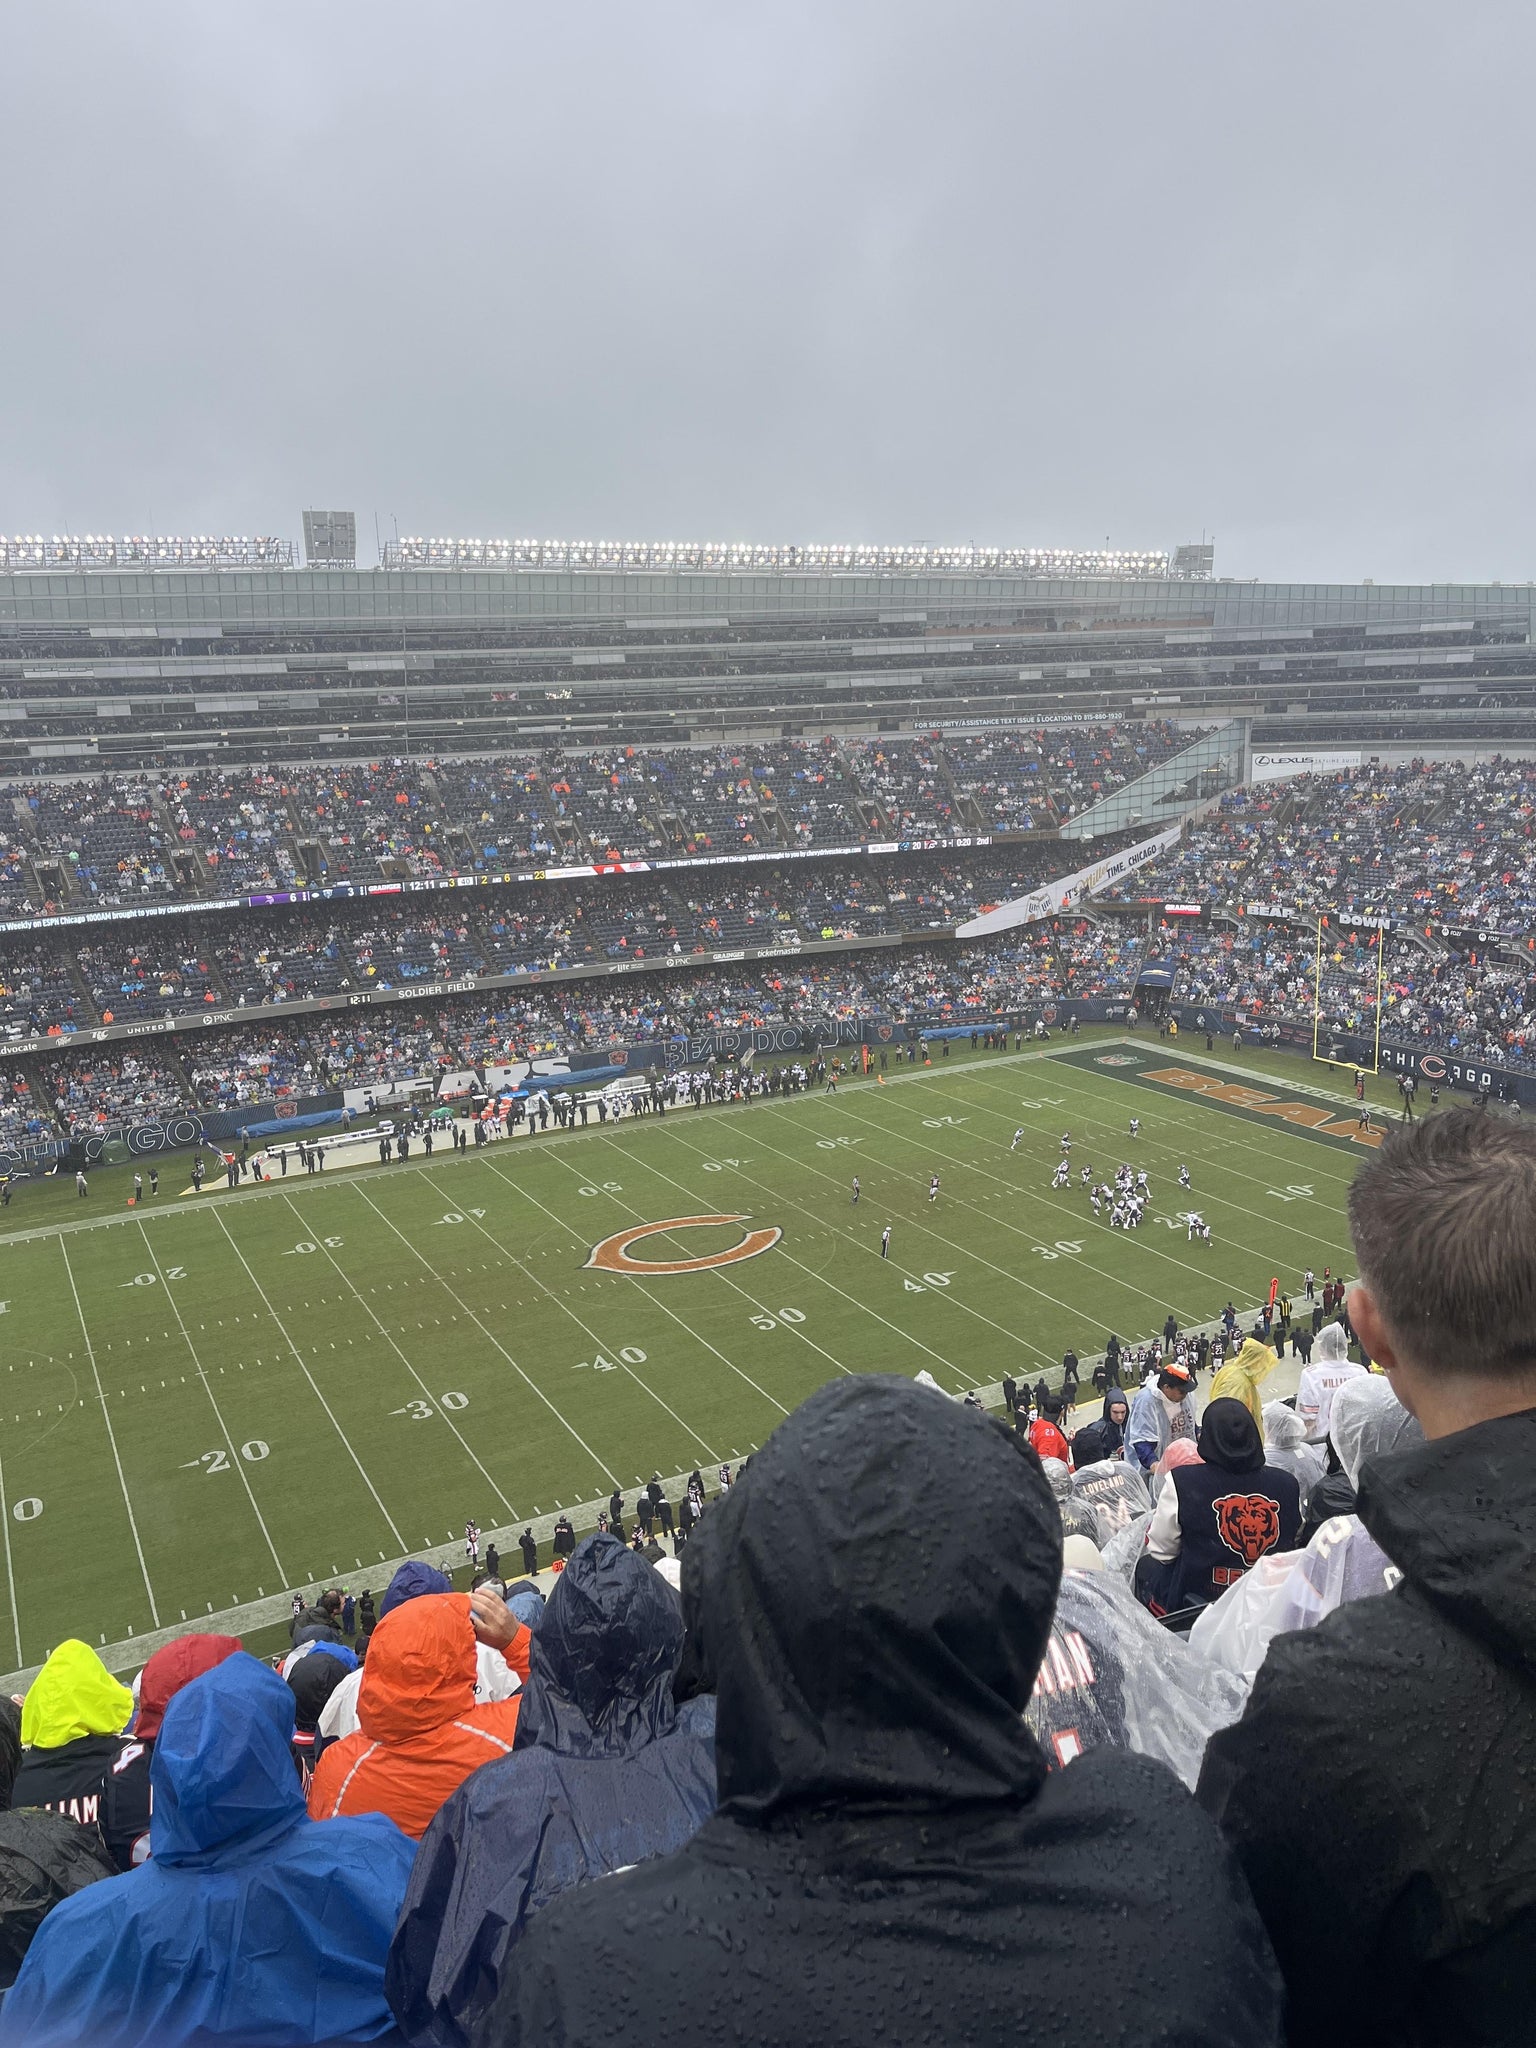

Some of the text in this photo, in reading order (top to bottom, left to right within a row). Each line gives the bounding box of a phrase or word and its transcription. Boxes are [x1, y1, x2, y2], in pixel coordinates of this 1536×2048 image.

[929, 718, 999, 728] SECURITY/ASSISTANCE
[1017, 716, 1035, 724] ISSUE
[1041, 715, 1073, 723] LOCATION
[912, 841, 921, 850] 20
[942, 839, 947, 848] 3
[976, 836, 989, 845] 2nd
[656, 861, 671, 869] Listen
[677, 860, 691, 868] Bears
[692, 859, 709, 867] Weekly
[729, 855, 747, 864] Chicago
[1106, 861, 1126, 879] TIME,
[1128, 845, 1157, 867] CHICAGO
[409, 880, 435, 891] 12:11
[449, 879, 455, 887] 3
[481, 875, 488, 884] 2
[504, 873, 511, 882] 6
[534, 870, 545, 880] 23
[289, 893, 297, 902] 6
[347, 887, 355, 897] 3
[7, 921, 32, 931] Weekly
[33, 920, 42, 928] on
[43, 918, 60, 927] ESPN
[60, 916, 86, 924] Chicago
[86, 912, 112, 921] 1000AM
[112, 908, 137, 919] brought
[138, 909, 145, 917] to
[145, 908, 157, 917] you
[159, 907, 166, 915] by
[167, 900, 240, 913] chevydriveschicago.com
[1246, 905, 1295, 918] BEAR
[1339, 913, 1391, 929] DOWN
[712, 951, 745, 960] GRAINGER
[757, 947, 802, 958] ticketmaster
[675, 957, 691, 965] PNC
[398, 982, 476, 999] SOLDIER FIELD
[350, 994, 371, 1005] 12:11
[213, 1013, 234, 1023] PNC
[127, 1024, 165, 1034] UNITED
[0, 1043, 38, 1055] dvocate
[1137, 1068, 1386, 1149] BEAR
[1266, 1184, 1314, 1202] 10
[1031, 1239, 1082, 1260] 30
[902, 1271, 951, 1295] 40
[748, 1307, 807, 1331] 50
[588, 1346, 648, 1373] 40
[406, 1391, 470, 1420] 30
[201, 1439, 271, 1474] 20
[1082, 1475, 1125, 1496] LOVELAND
[1033, 1632, 1097, 1697] MAN
[112, 1744, 145, 1775] 4
[45, 1794, 101, 1825] IAM
